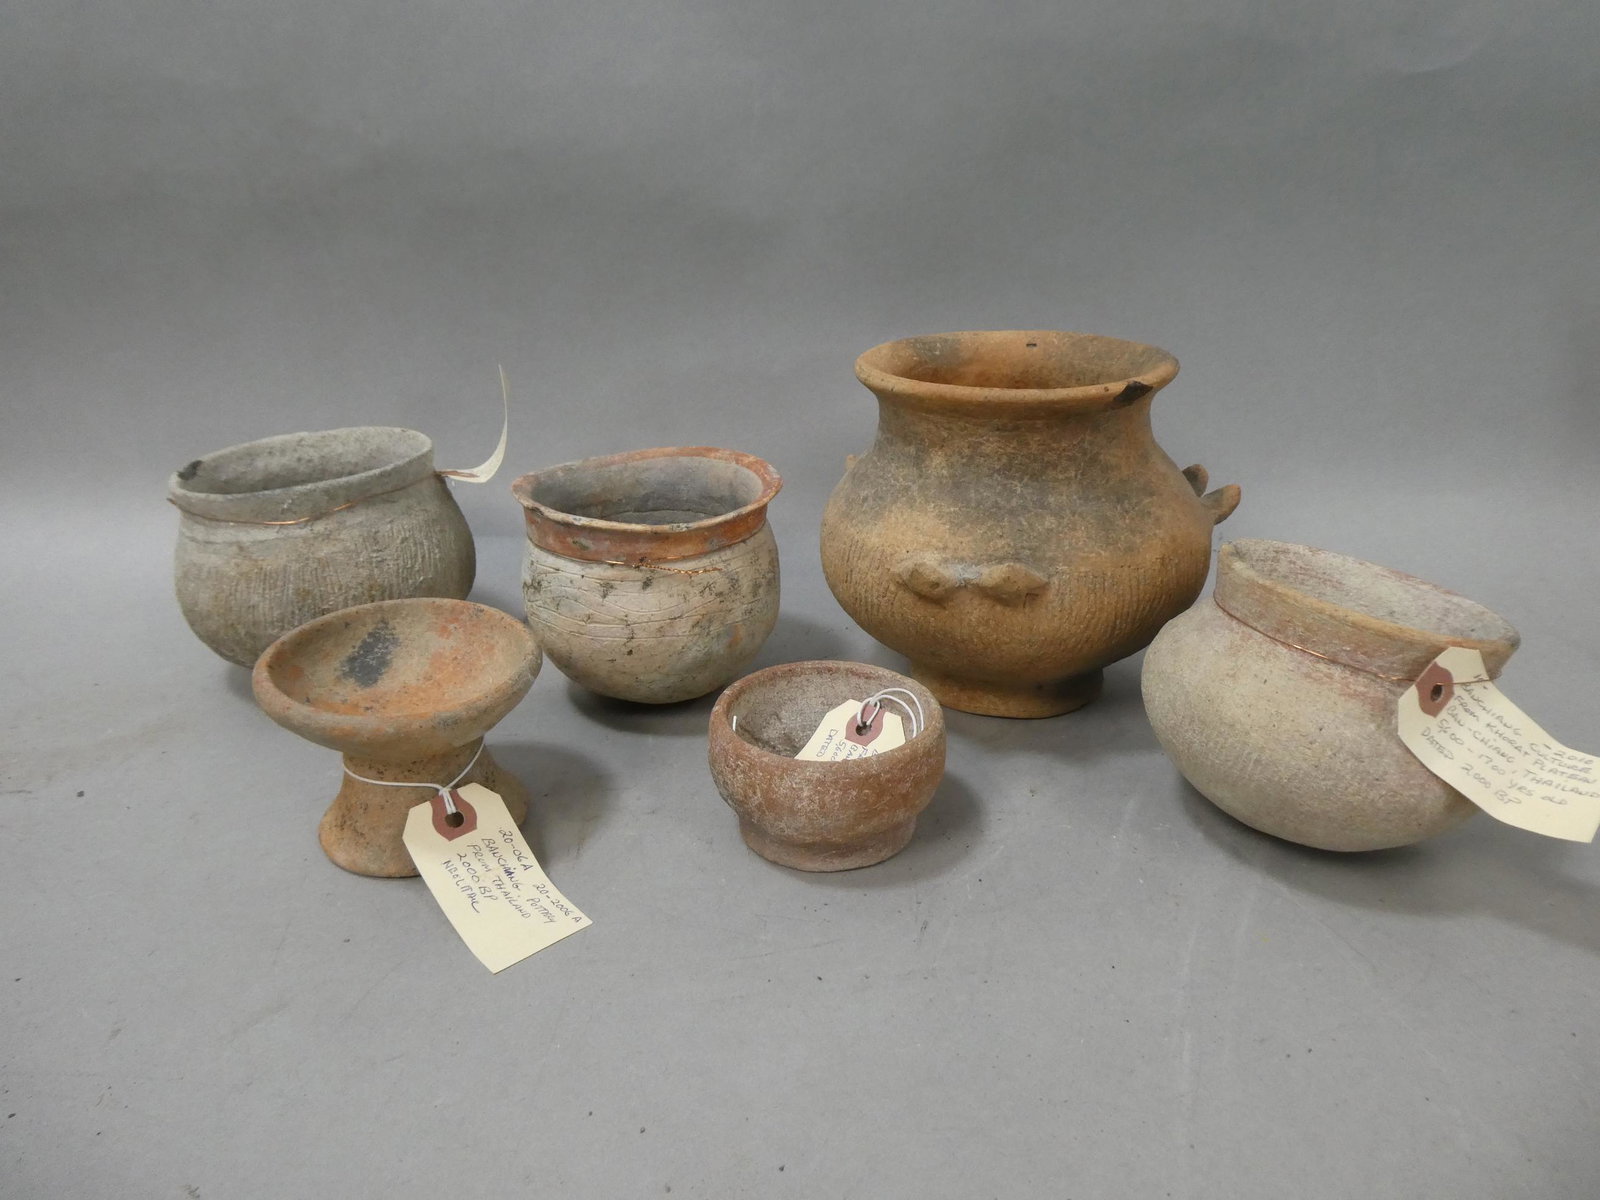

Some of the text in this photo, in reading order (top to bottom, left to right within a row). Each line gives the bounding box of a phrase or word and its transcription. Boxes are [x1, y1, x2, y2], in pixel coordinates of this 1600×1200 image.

[816, 728, 838, 758] DATED
[457, 852, 498, 902] 2000 BP
